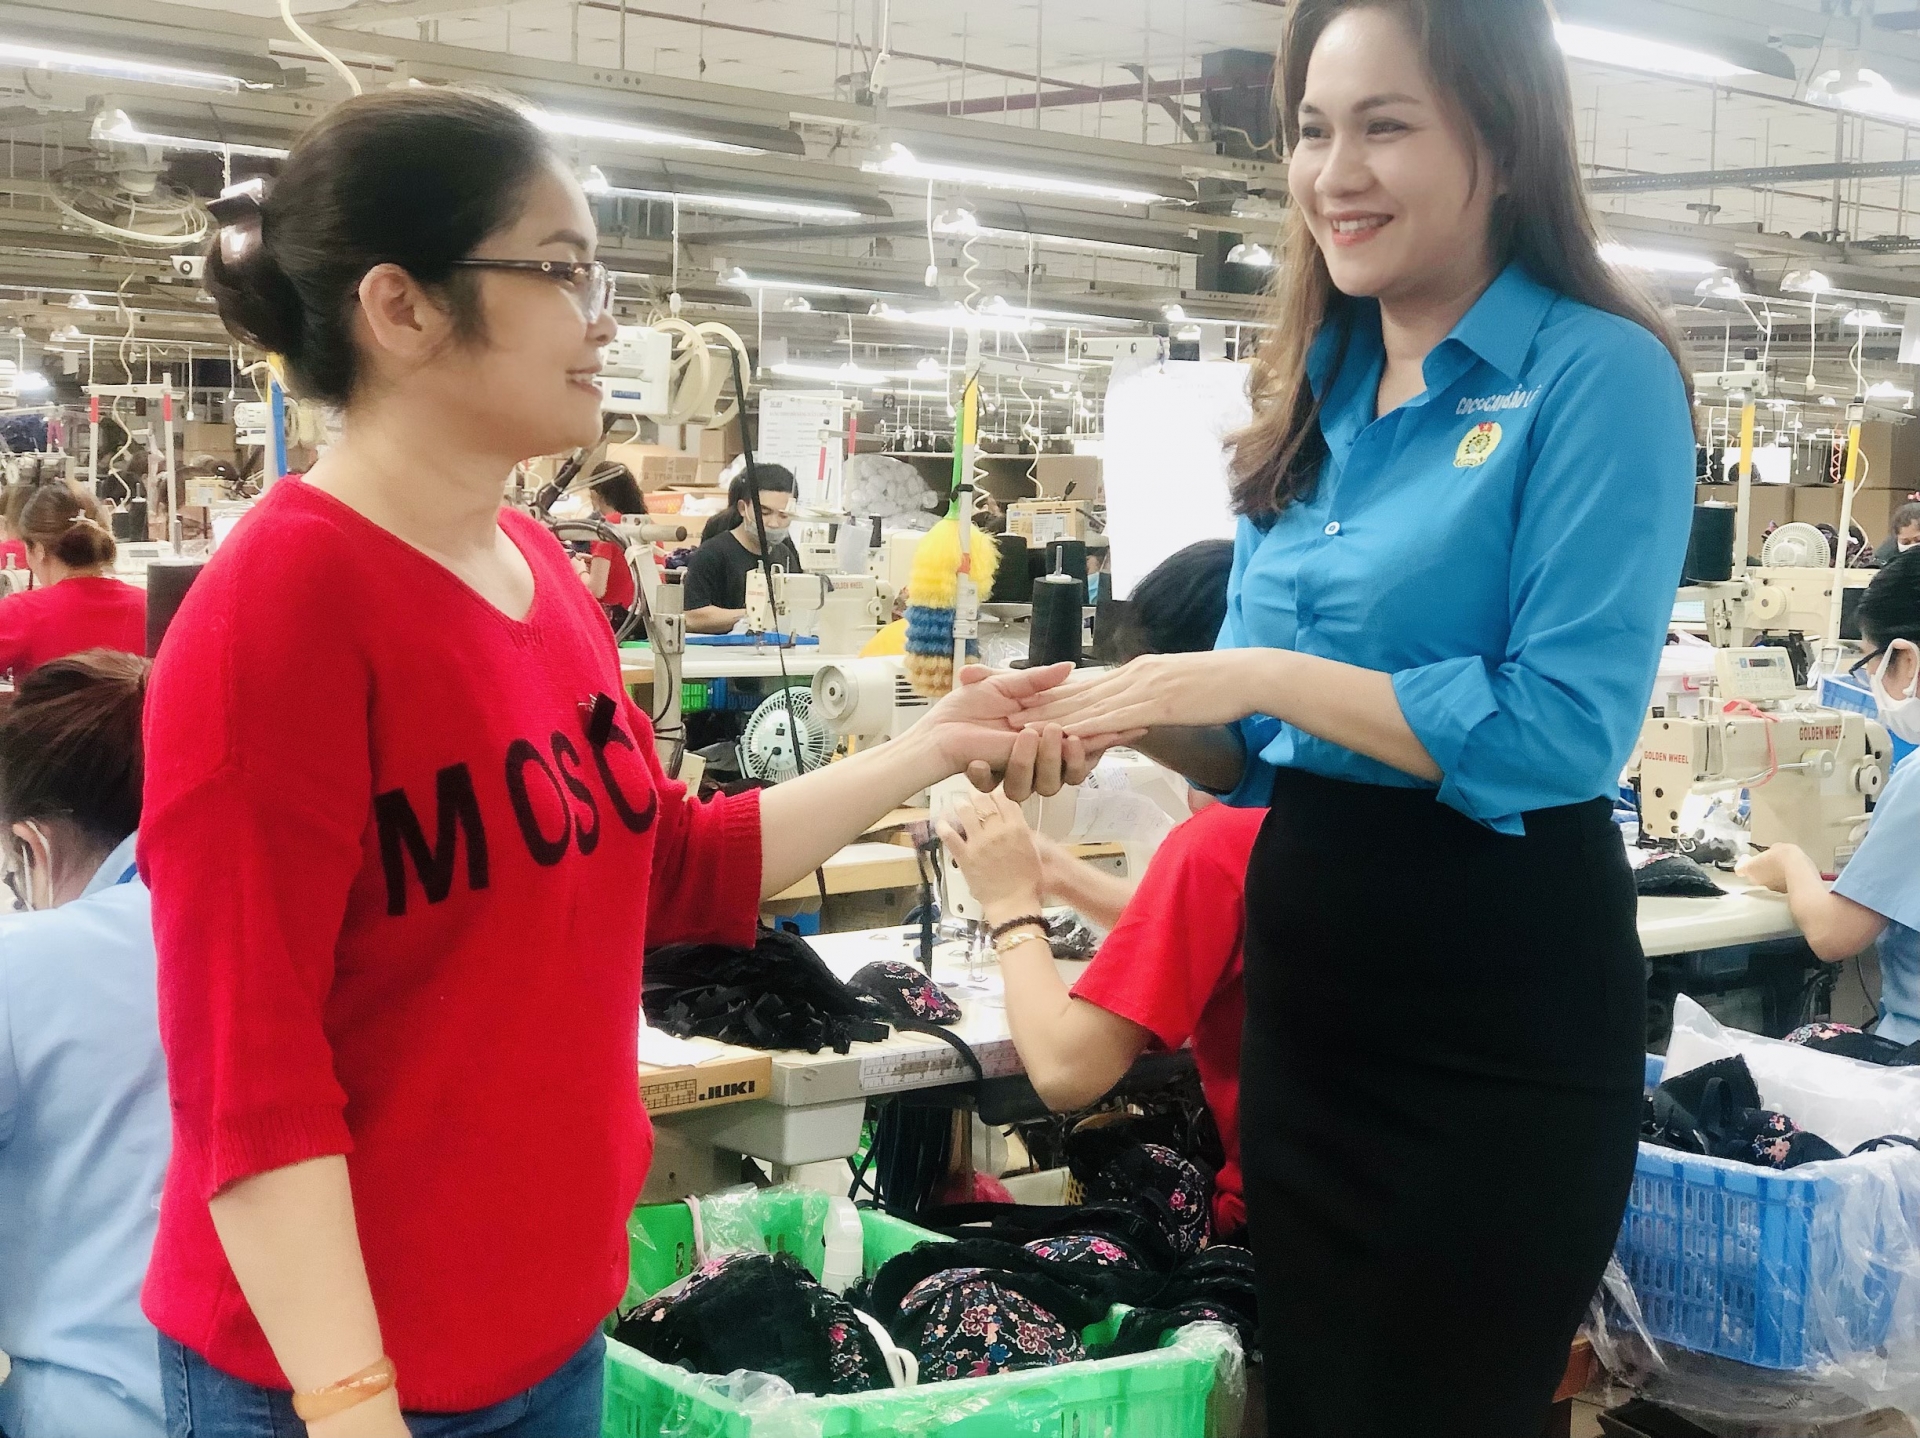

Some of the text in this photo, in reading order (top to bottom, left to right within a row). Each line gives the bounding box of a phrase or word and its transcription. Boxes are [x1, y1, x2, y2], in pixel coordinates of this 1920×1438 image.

[1799, 725, 1846, 740] GOLDEN WHEE
[1644, 750, 1689, 764] GOLDEN WHEEL
[698, 1080, 755, 1101] JUKI
